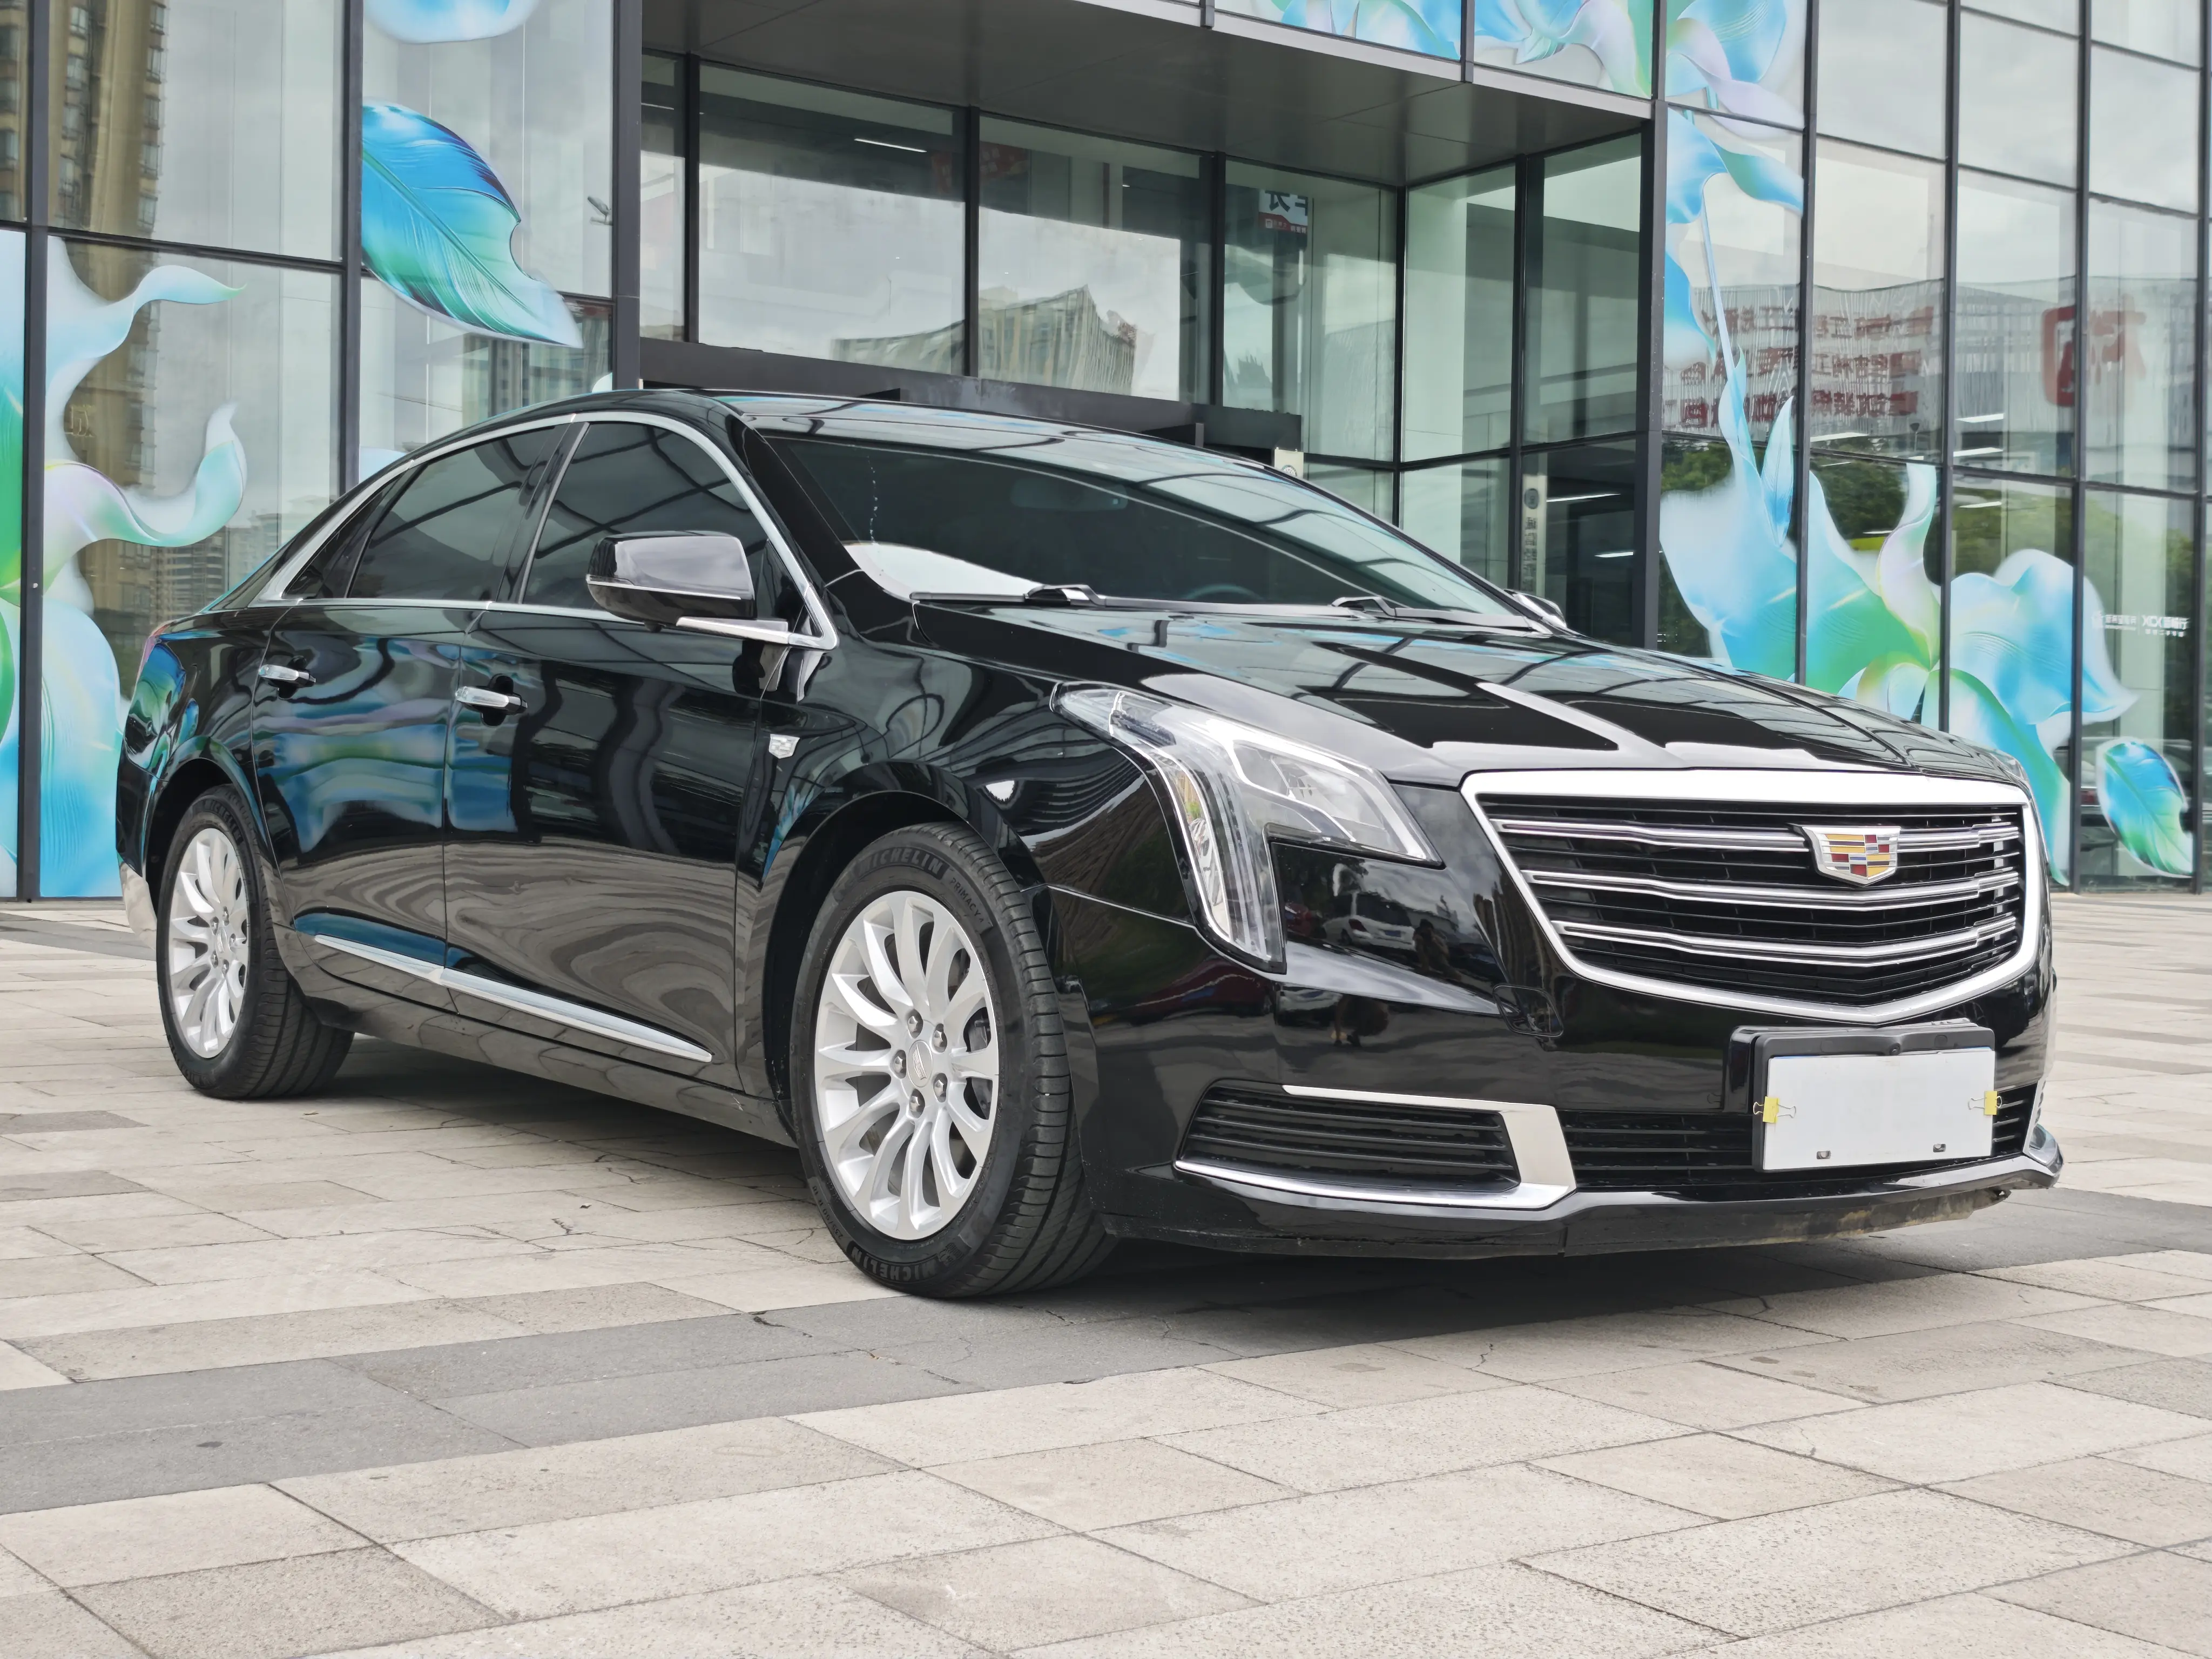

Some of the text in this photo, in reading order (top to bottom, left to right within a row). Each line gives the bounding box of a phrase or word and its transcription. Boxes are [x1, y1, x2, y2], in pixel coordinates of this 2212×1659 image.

[858, 847, 943, 875] MICHELIN
[950, 877, 981, 917] PRIMACY
[851, 1246, 938, 1282] MICHELIN
